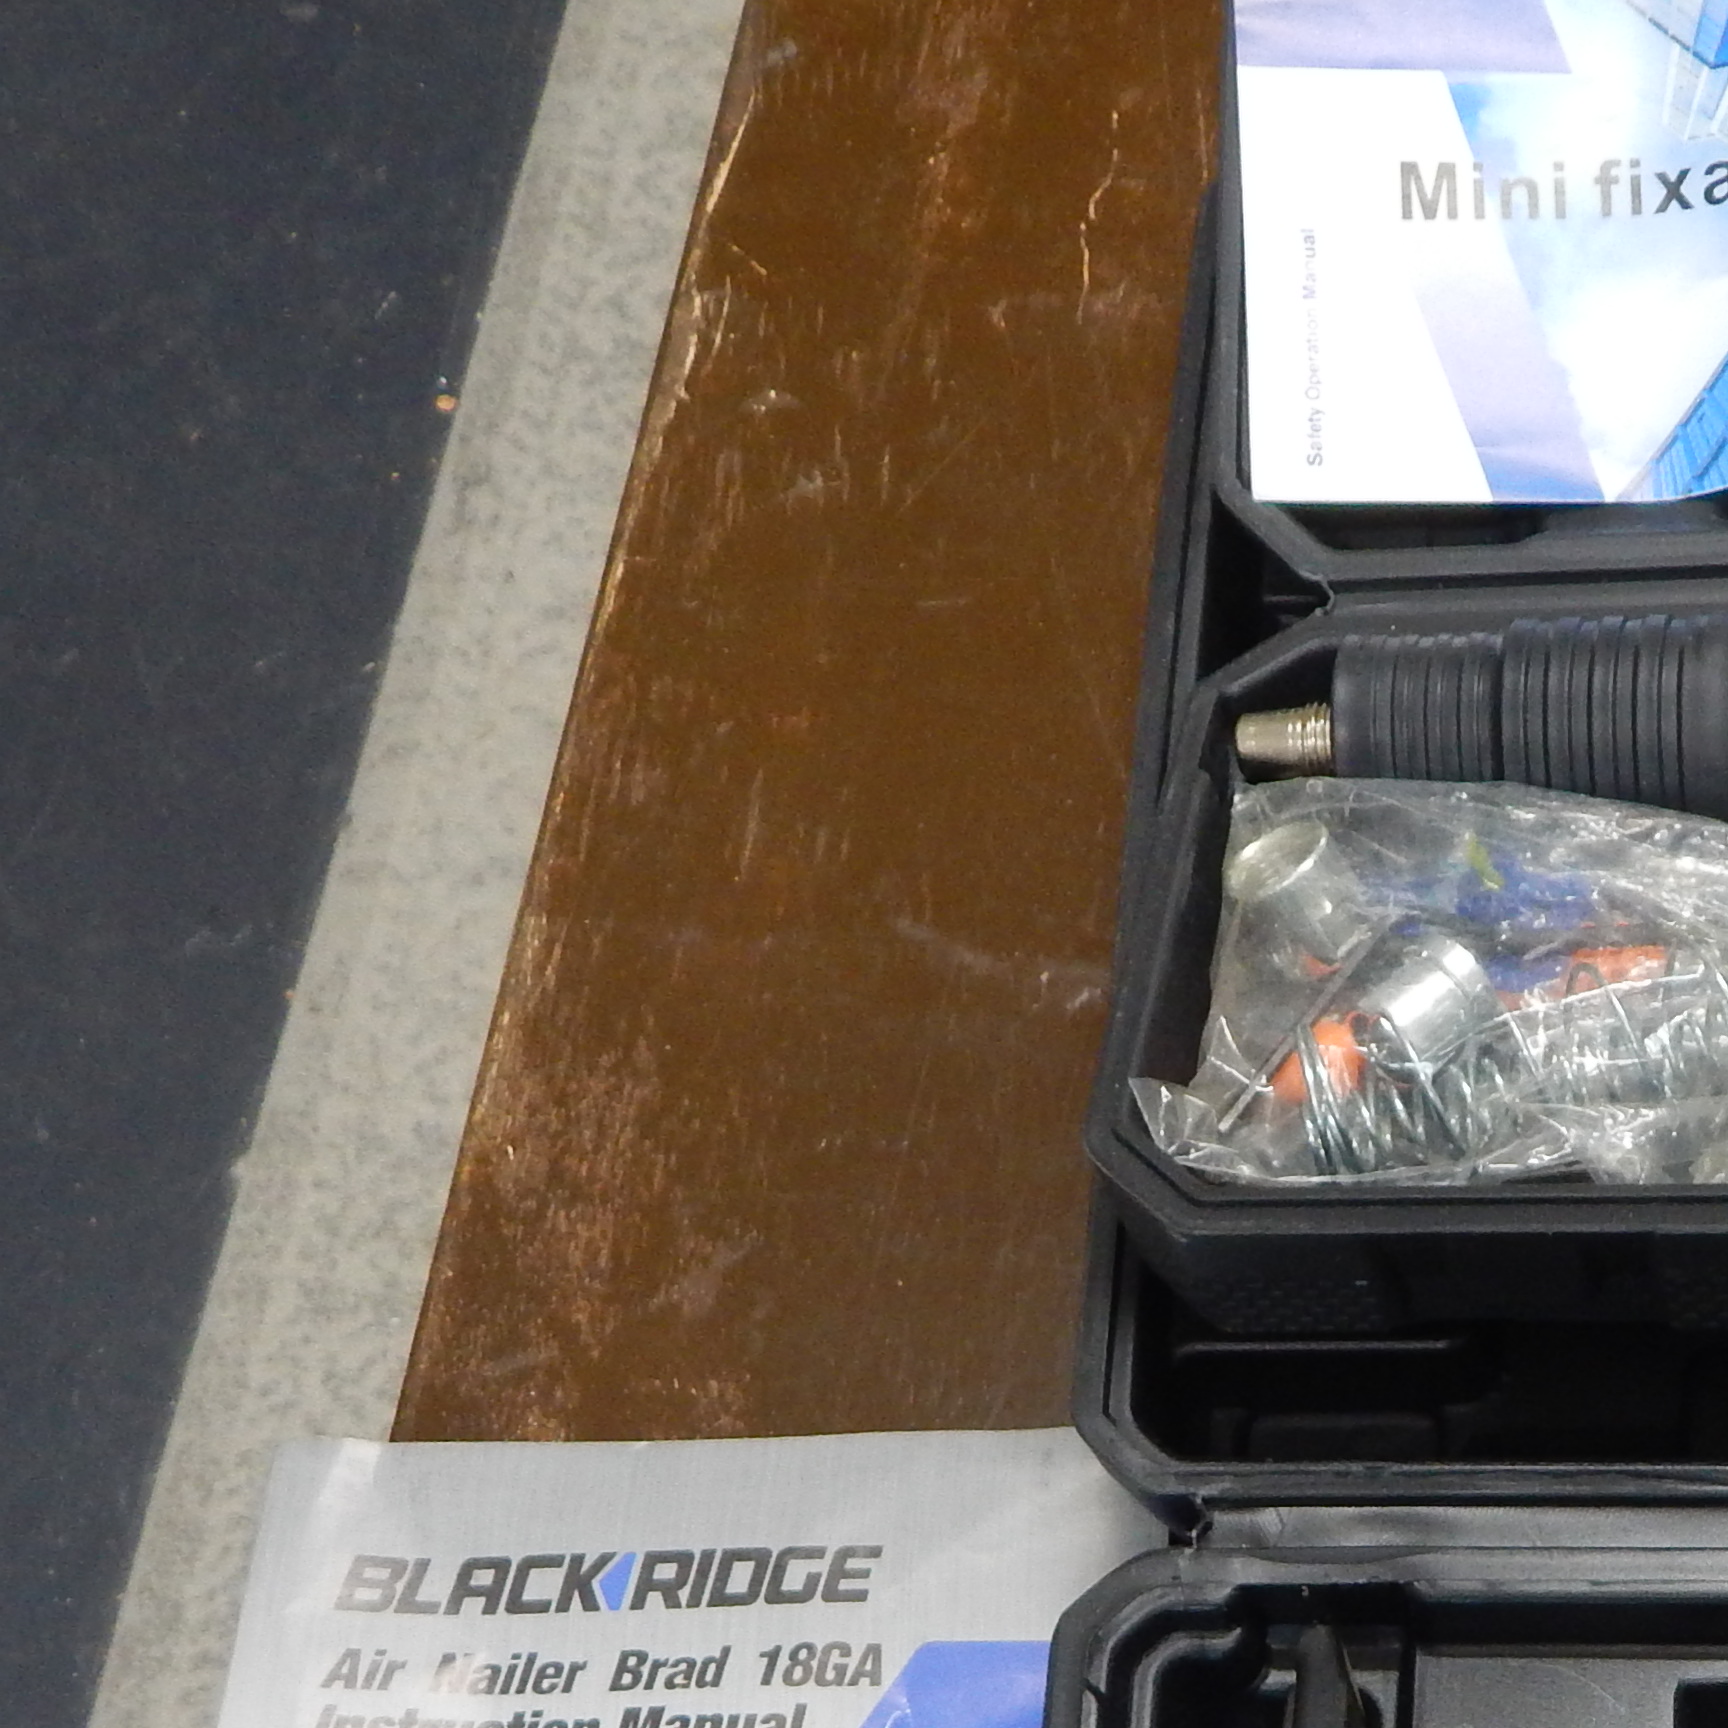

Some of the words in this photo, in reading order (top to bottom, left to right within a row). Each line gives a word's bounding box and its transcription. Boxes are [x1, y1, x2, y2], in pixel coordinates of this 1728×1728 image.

[1399, 160, 1568, 221] Mini
[1301, 228, 1318, 300] Manual
[1304, 306, 1323, 402] Operation
[1306, 405, 1326, 468] Safety
[320, 1647, 407, 1692] Air
[430, 1650, 588, 1697] Nailer
[609, 1644, 732, 1693] Brad
[757, 1641, 884, 1689] 18GA
